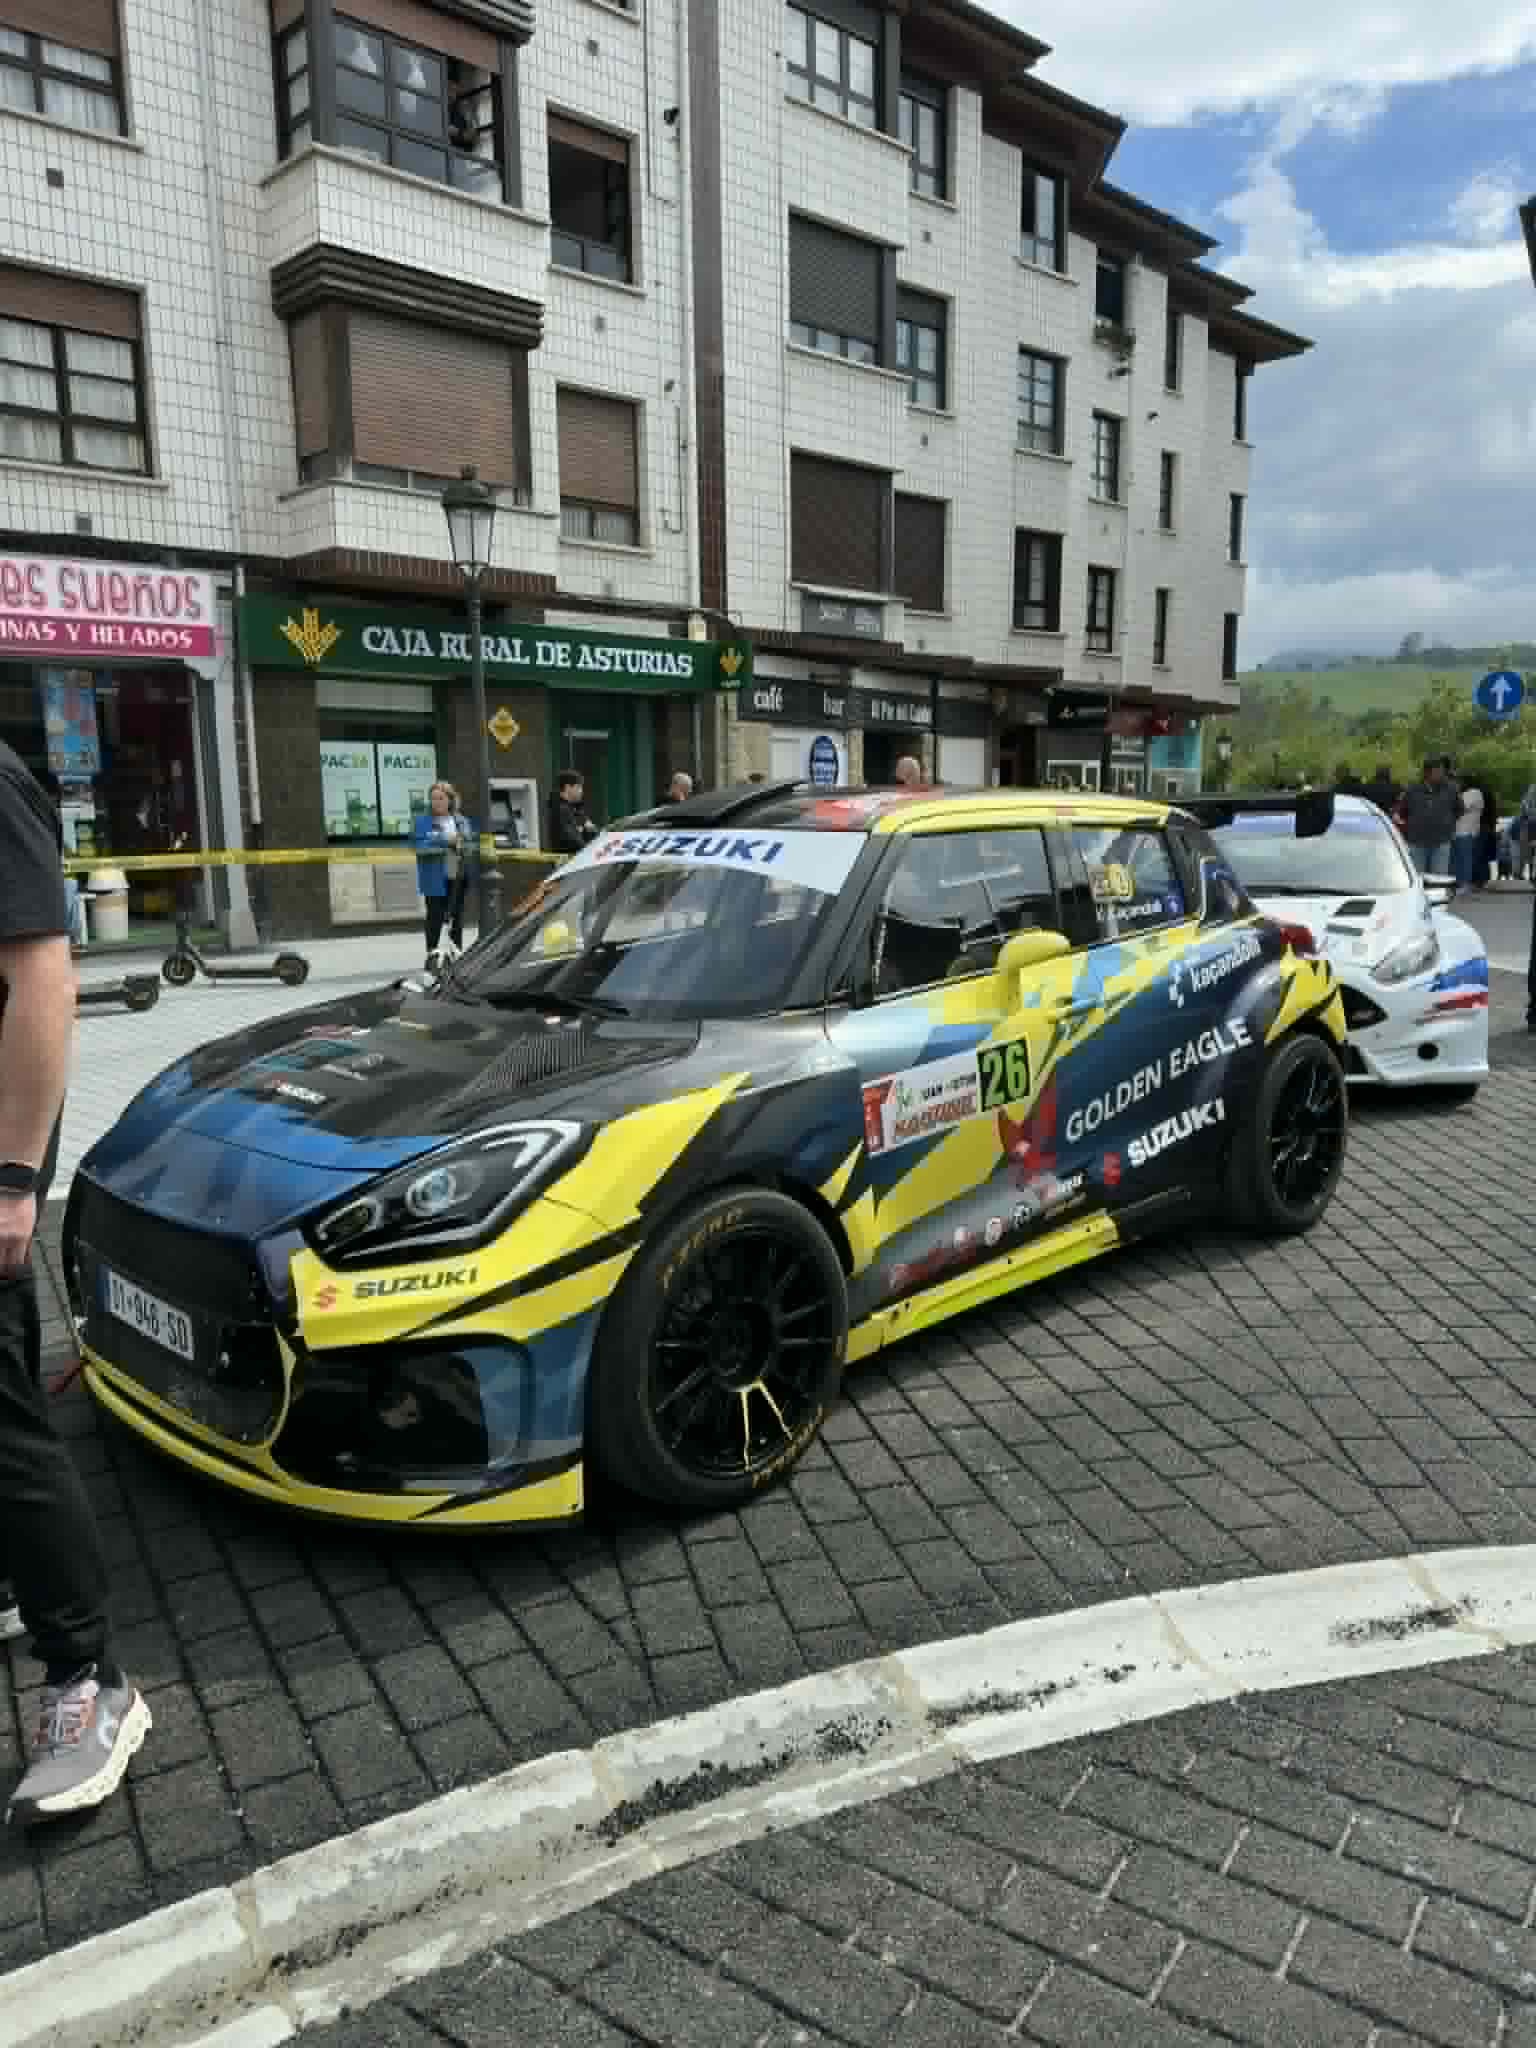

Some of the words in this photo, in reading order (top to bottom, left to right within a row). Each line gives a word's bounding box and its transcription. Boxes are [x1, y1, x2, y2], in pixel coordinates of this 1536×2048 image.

[66, 622, 80, 642] Y
[89, 623, 193, 650] HELADOS
[361, 625, 434, 657] CAJA
[439, 631, 530, 666] RURAL
[535, 640, 571, 668] DE
[576, 645, 693, 679] ASTURIAS
[753, 684, 784, 713] café
[612, 836, 785, 863] SUZUKI
[982, 1042, 1026, 1105] 26
[1065, 1059, 1162, 1143] GOLDEN
[1169, 1015, 1253, 1080] EAGLE
[1127, 1096, 1225, 1168] SUZUKI
[353, 1267, 478, 1299] SUZUKI
